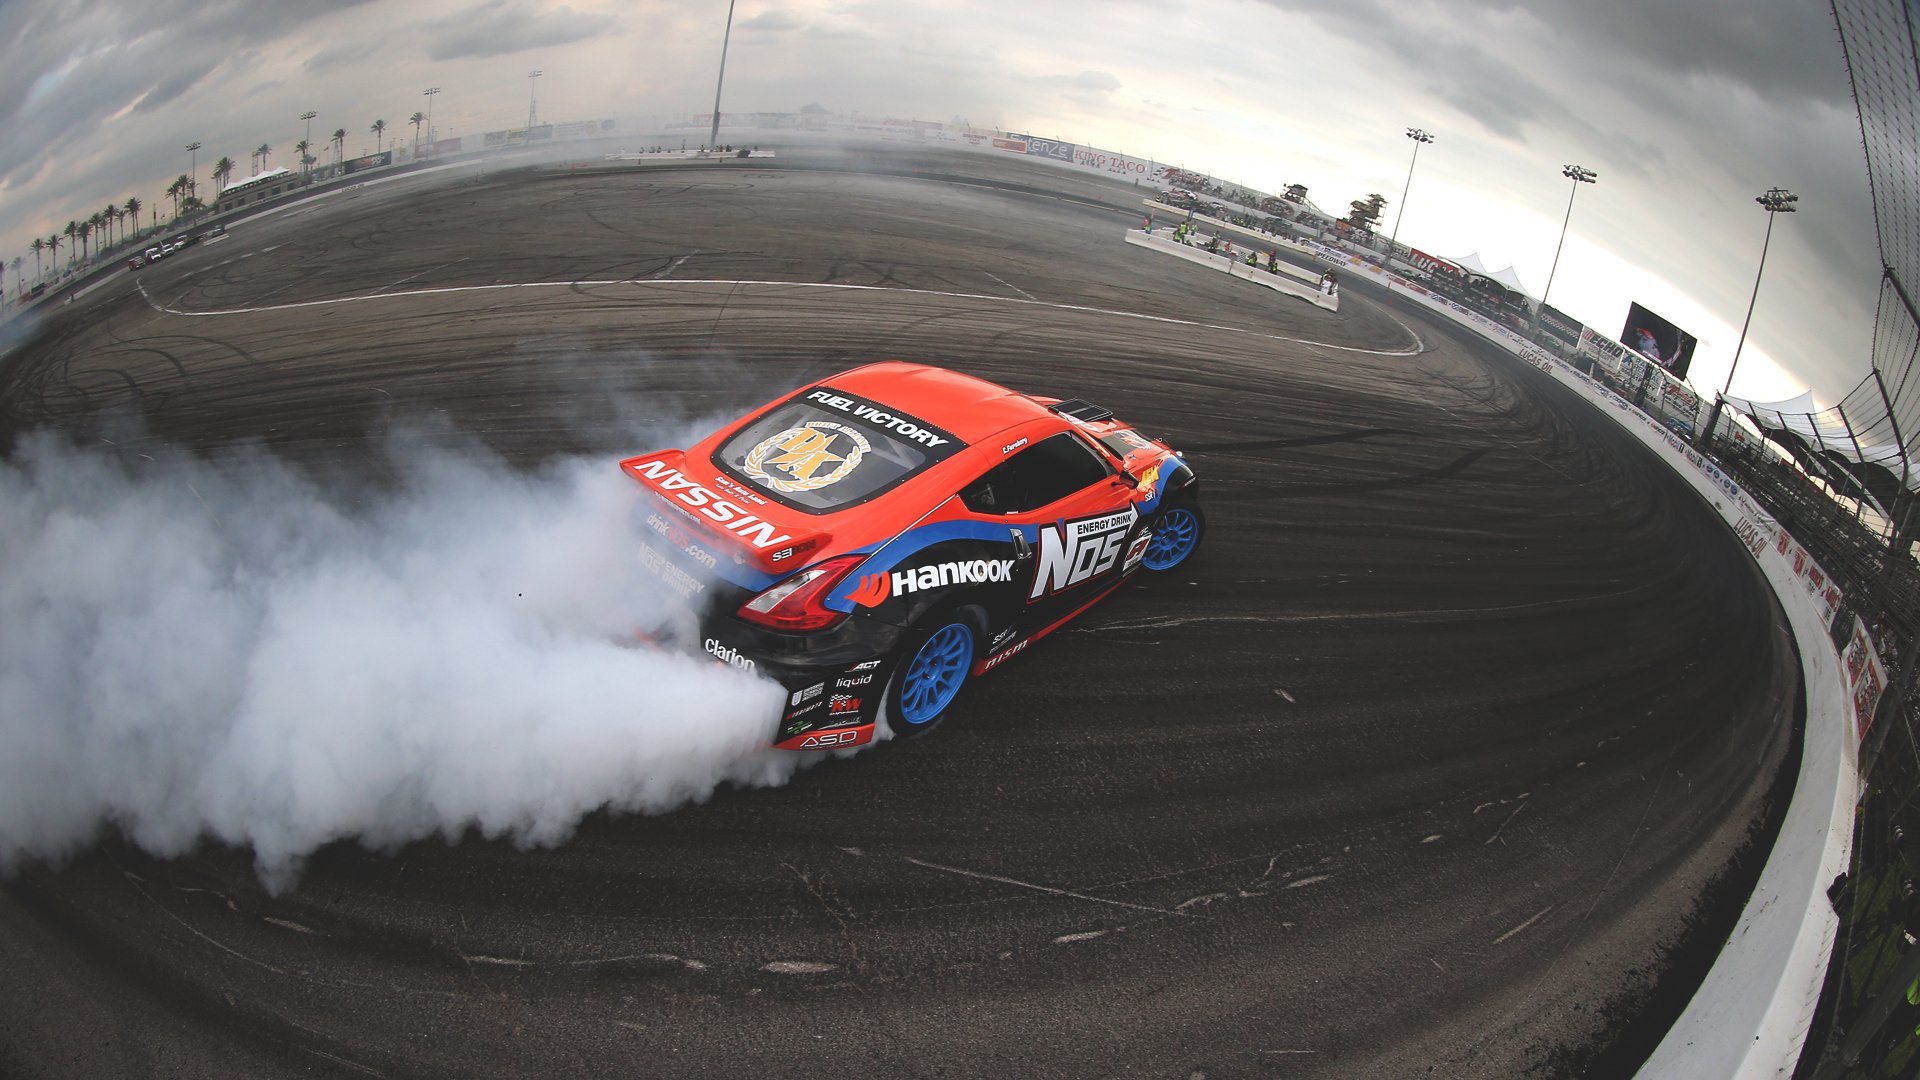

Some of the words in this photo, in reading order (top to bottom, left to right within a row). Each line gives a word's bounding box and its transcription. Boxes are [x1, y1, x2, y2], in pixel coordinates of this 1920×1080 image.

[1074, 149, 1106, 164] KING
[1110, 157, 1146, 173] TACO
[1409, 253, 1454, 274] LUC
[1590, 334, 1624, 358] ECHO
[1519, 348, 1542, 366] LUCAS
[1541, 362, 1553, 374] OIL
[806, 391, 852, 412] FUEL
[853, 402, 950, 448] VICTORY
[633, 460, 792, 548] NISSAN
[747, 494, 768, 505] Land
[1077, 519, 1110, 534] ENERGY
[1111, 513, 1132, 527] DRINK
[1733, 516, 1759, 546] LUCAS
[1751, 538, 1768, 560] OIL
[1031, 523, 1127, 599] NOS
[705, 638, 755, 671] Clarion
[850, 660, 881, 672] ACT
[836, 674, 873, 688] liquid
[831, 698, 863, 713] KW
[800, 731, 857, 748] ASD
